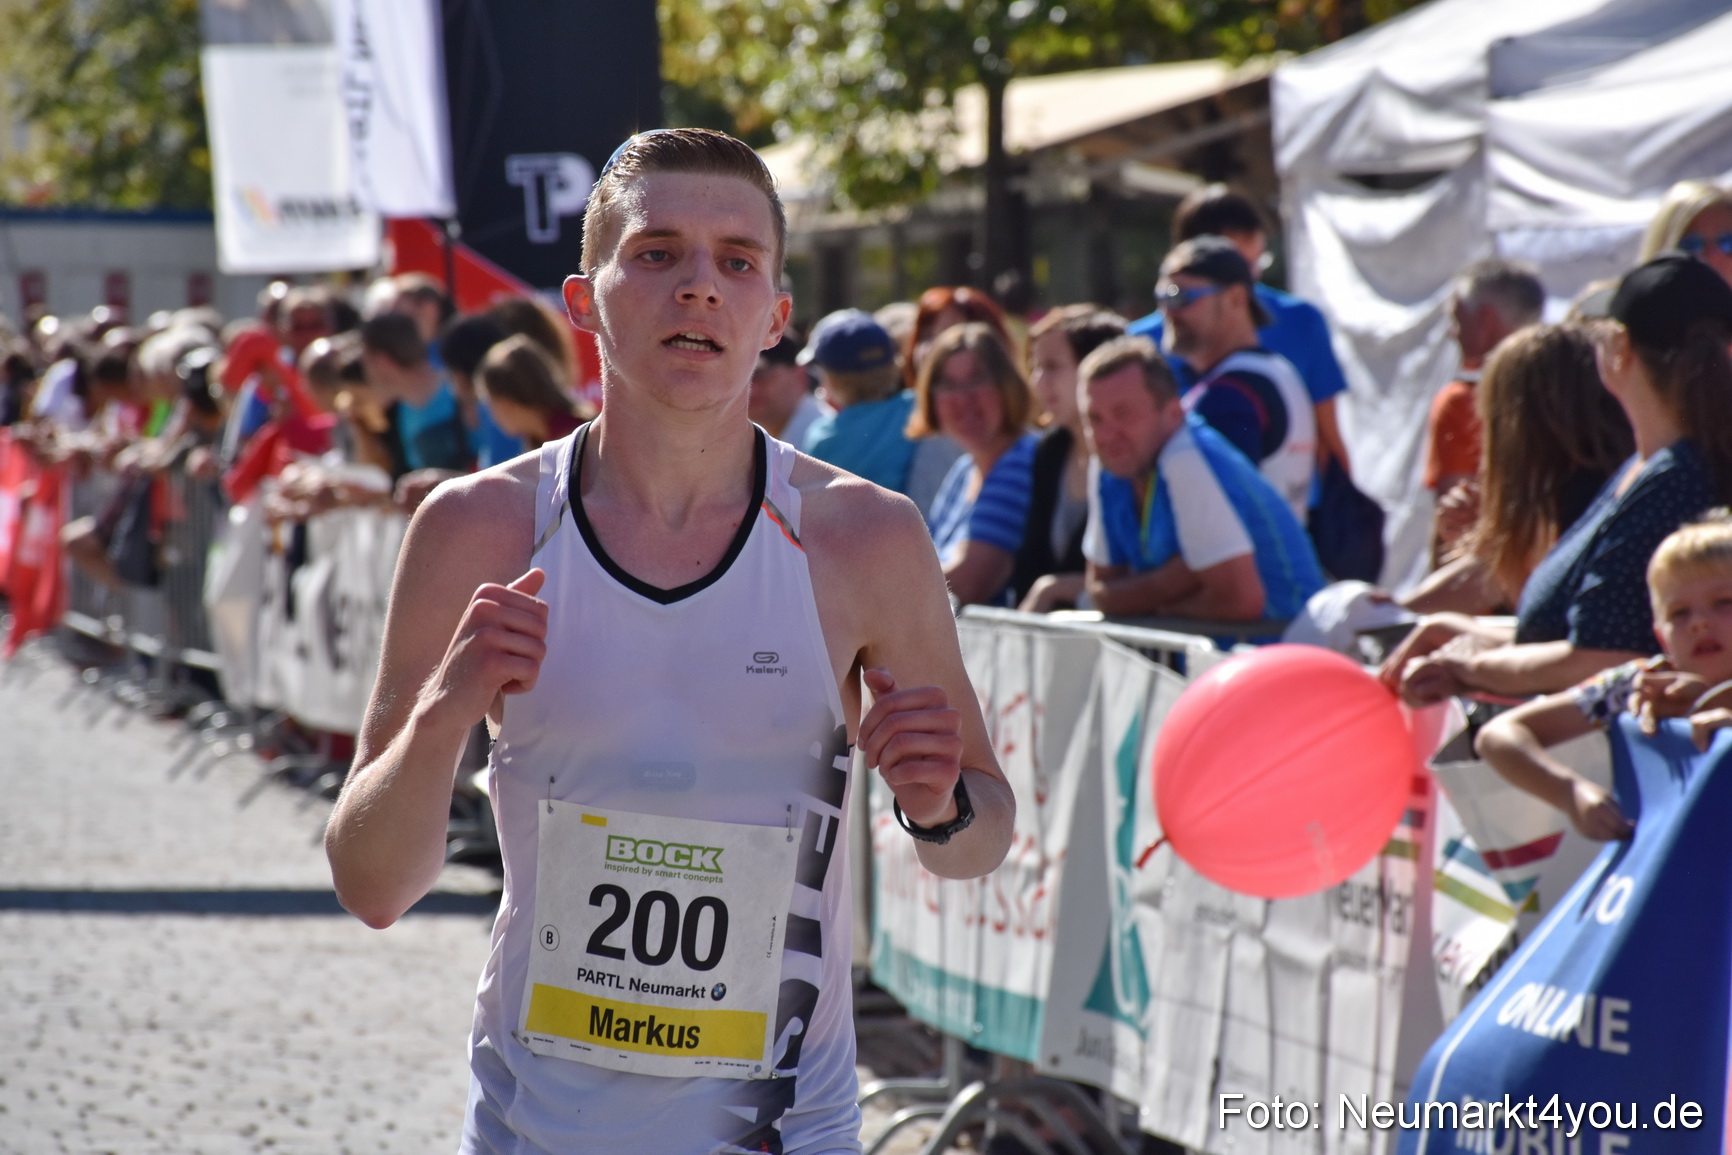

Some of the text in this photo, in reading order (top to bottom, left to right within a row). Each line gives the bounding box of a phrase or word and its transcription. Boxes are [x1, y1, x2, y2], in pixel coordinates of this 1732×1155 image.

[746, 665, 788, 677] Kalenji
[604, 861, 724, 884] inspired by smart concepts
[605, 834, 724, 874] BOCK
[585, 883, 729, 971] 200
[577, 967, 706, 999] PARTL Neumarkt
[589, 1005, 701, 1050] Markus
[1496, 982, 1632, 1056] ONLINE
